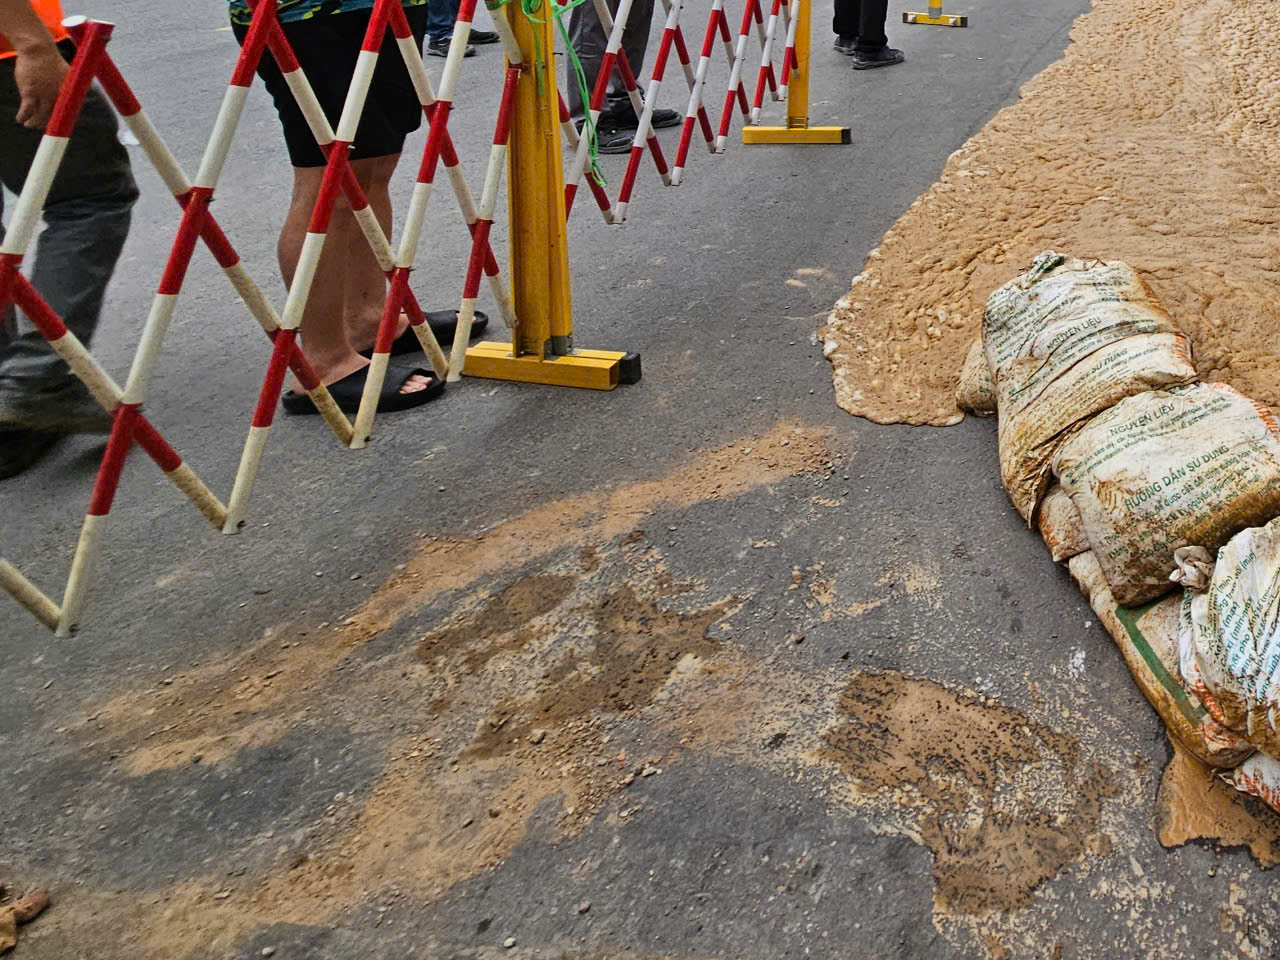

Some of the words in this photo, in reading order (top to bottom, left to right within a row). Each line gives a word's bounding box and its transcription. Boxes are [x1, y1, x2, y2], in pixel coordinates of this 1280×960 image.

[1109, 414, 1152, 437] NGUYÊN
[1154, 402, 1176, 422] LIỆU
[1163, 466, 1187, 487] DẪN
[1202, 443, 1230, 465] DỤNG
